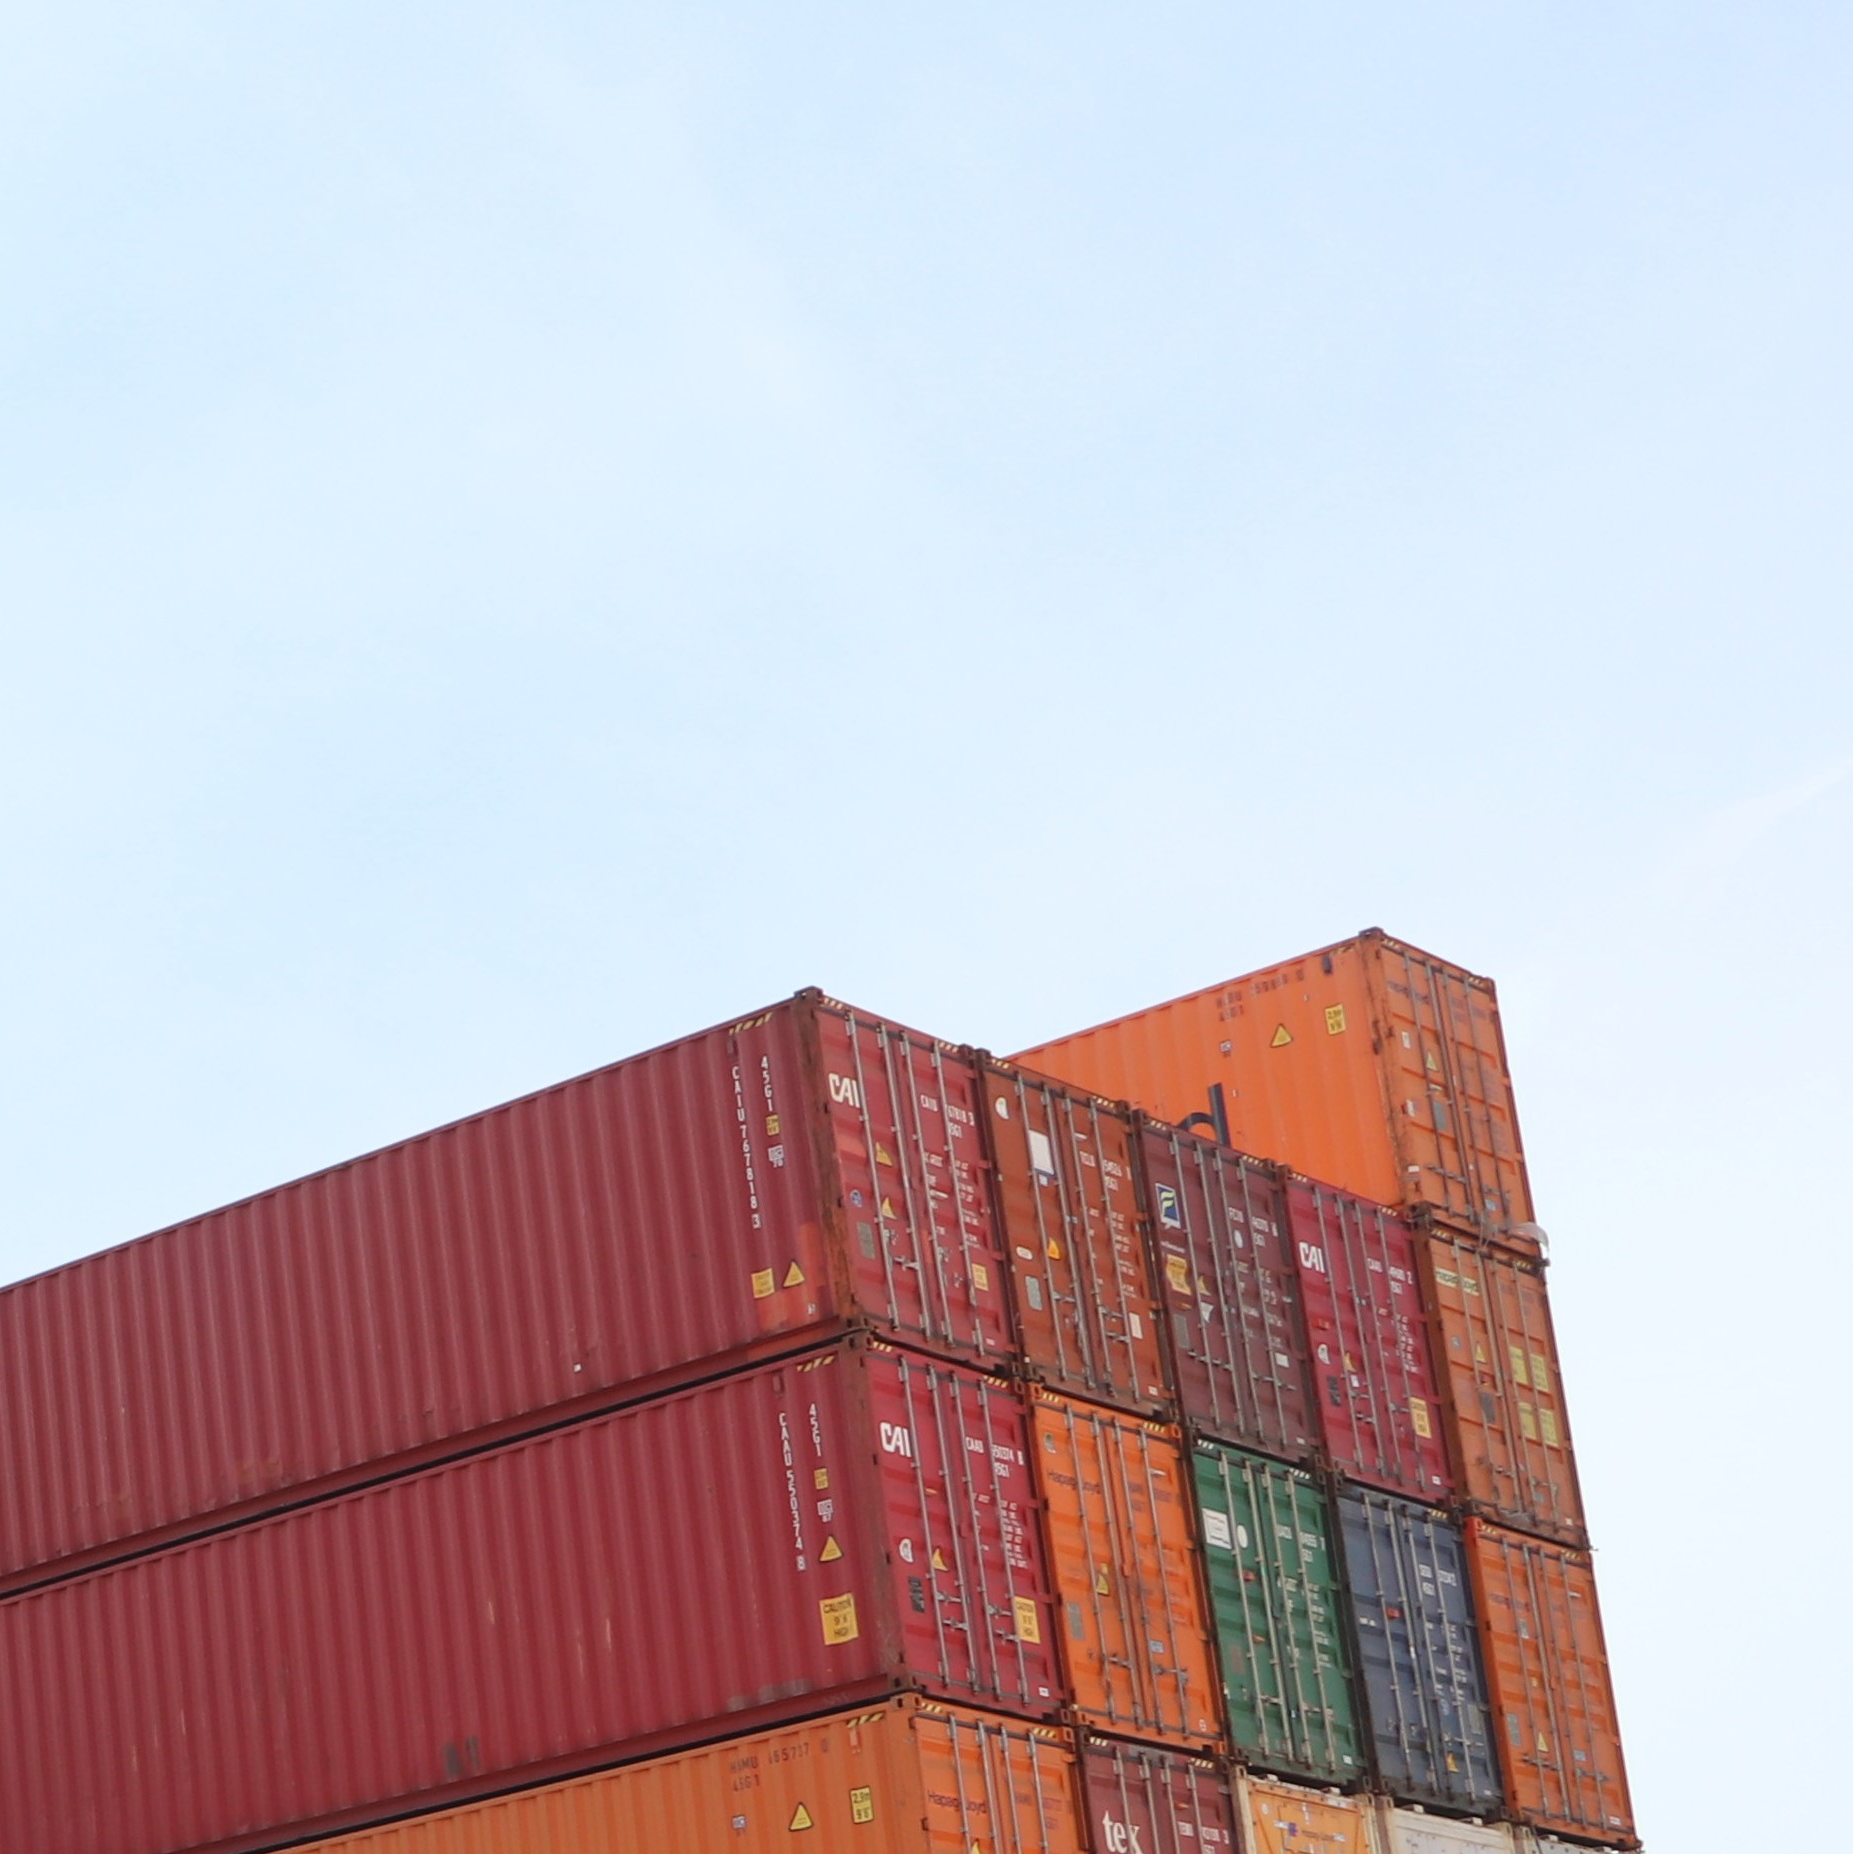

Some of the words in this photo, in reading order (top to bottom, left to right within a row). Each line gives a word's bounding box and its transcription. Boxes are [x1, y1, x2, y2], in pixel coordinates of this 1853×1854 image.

[760, 1055, 773, 1111] 45G1
[828, 1072, 862, 1109] CAI
[1298, 1241, 1326, 1274] CAI
[809, 1402, 822, 1457] 45G1
[879, 1422, 912, 1458] CAI
